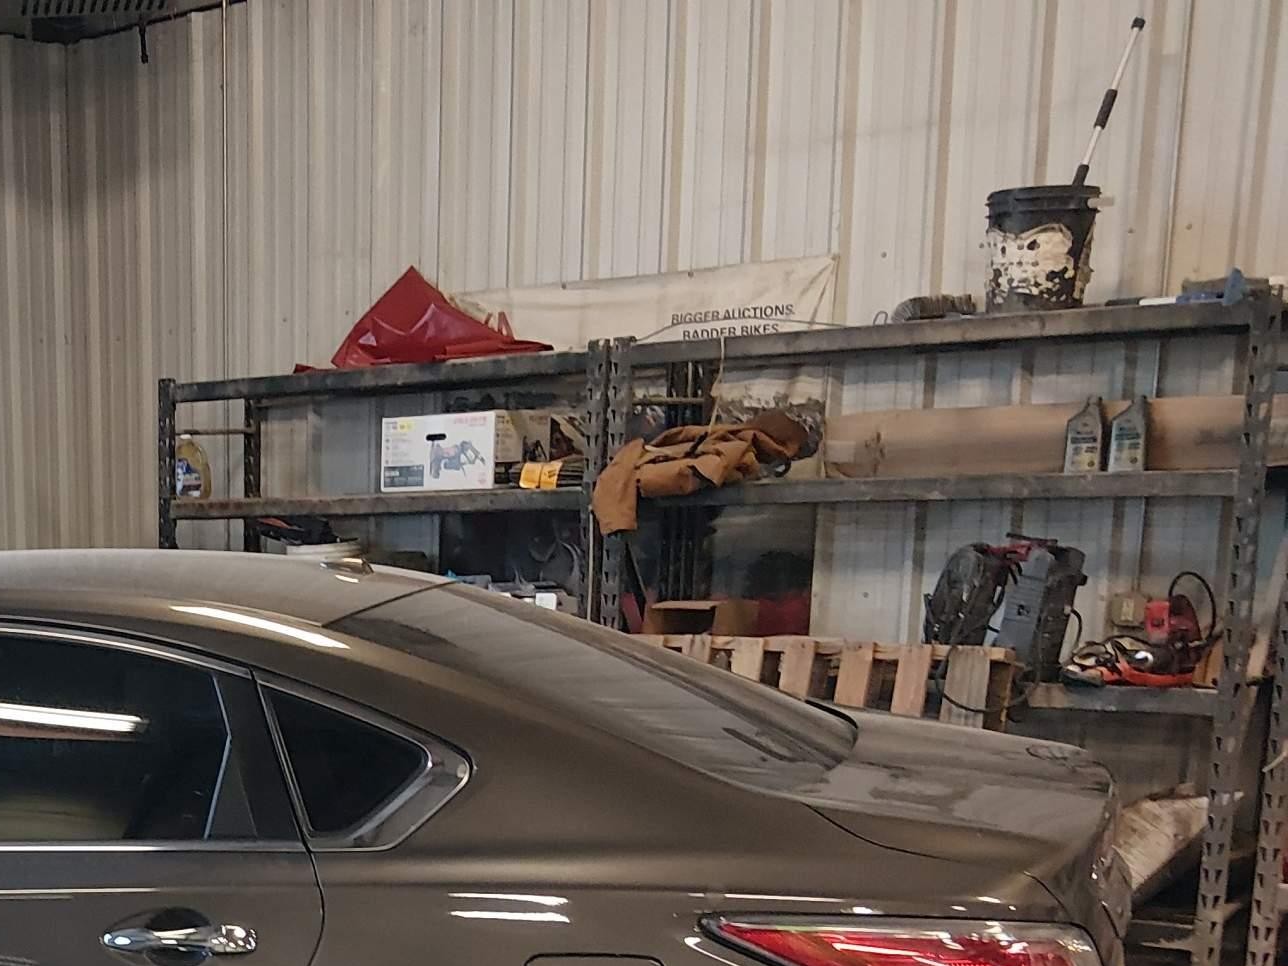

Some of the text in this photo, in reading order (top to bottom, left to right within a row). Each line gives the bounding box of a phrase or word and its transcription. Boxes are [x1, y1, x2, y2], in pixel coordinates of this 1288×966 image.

[671, 310, 720, 325] BIGGER
[682, 323, 779, 341] BADDER BIKES
